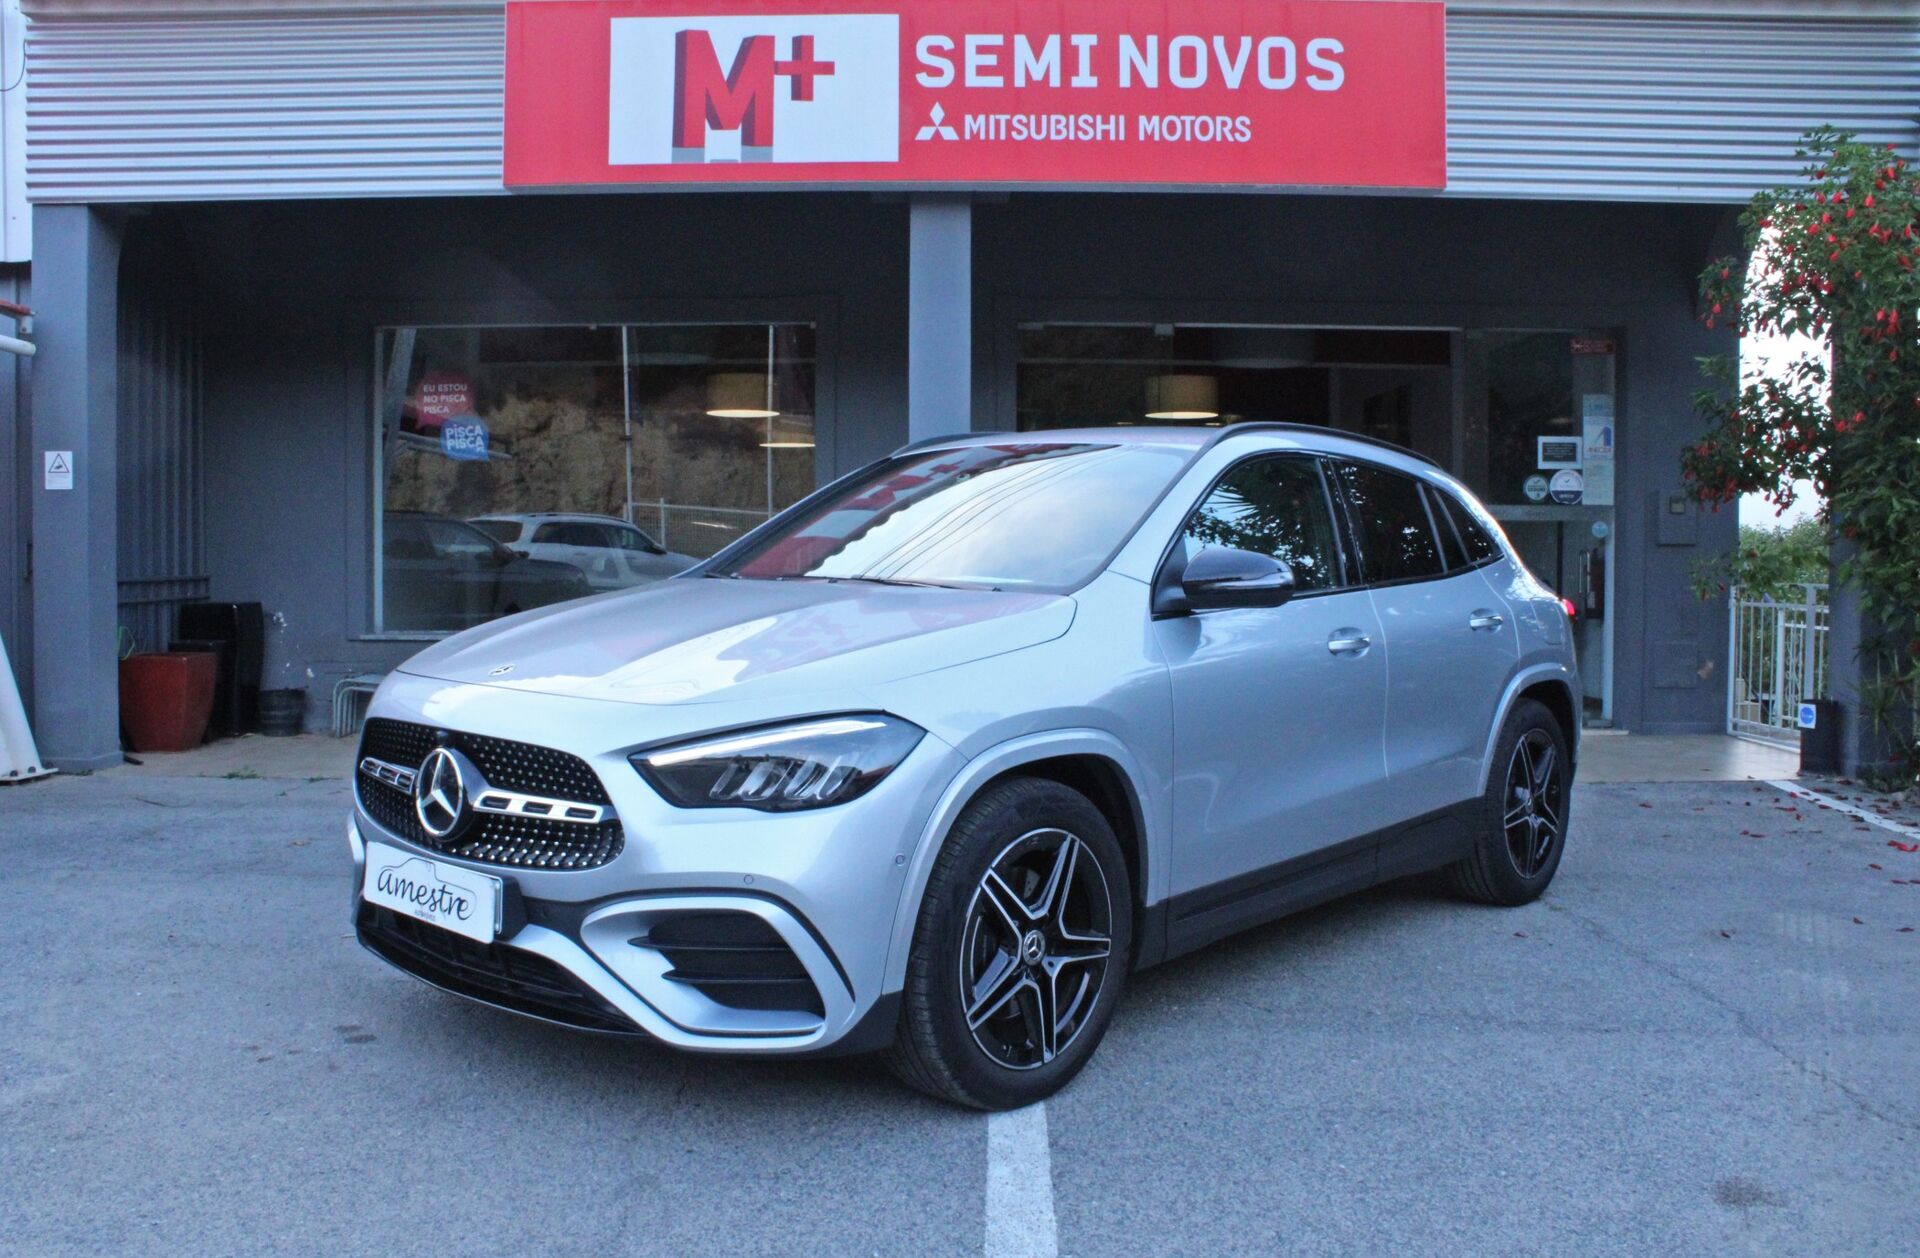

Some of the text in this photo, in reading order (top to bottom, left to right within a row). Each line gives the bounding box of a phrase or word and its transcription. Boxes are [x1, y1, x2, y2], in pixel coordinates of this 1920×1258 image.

[915, 34, 1345, 91] SEMI NOVOS
[671, 29, 835, 149] M+
[964, 114, 1251, 142] MITSUBISHI MOTORS
[423, 383, 468, 392] EU ESTOU
[423, 393, 466, 403] NO PISCA
[423, 405, 450, 414] PISCA
[377, 868, 469, 921] amestre
